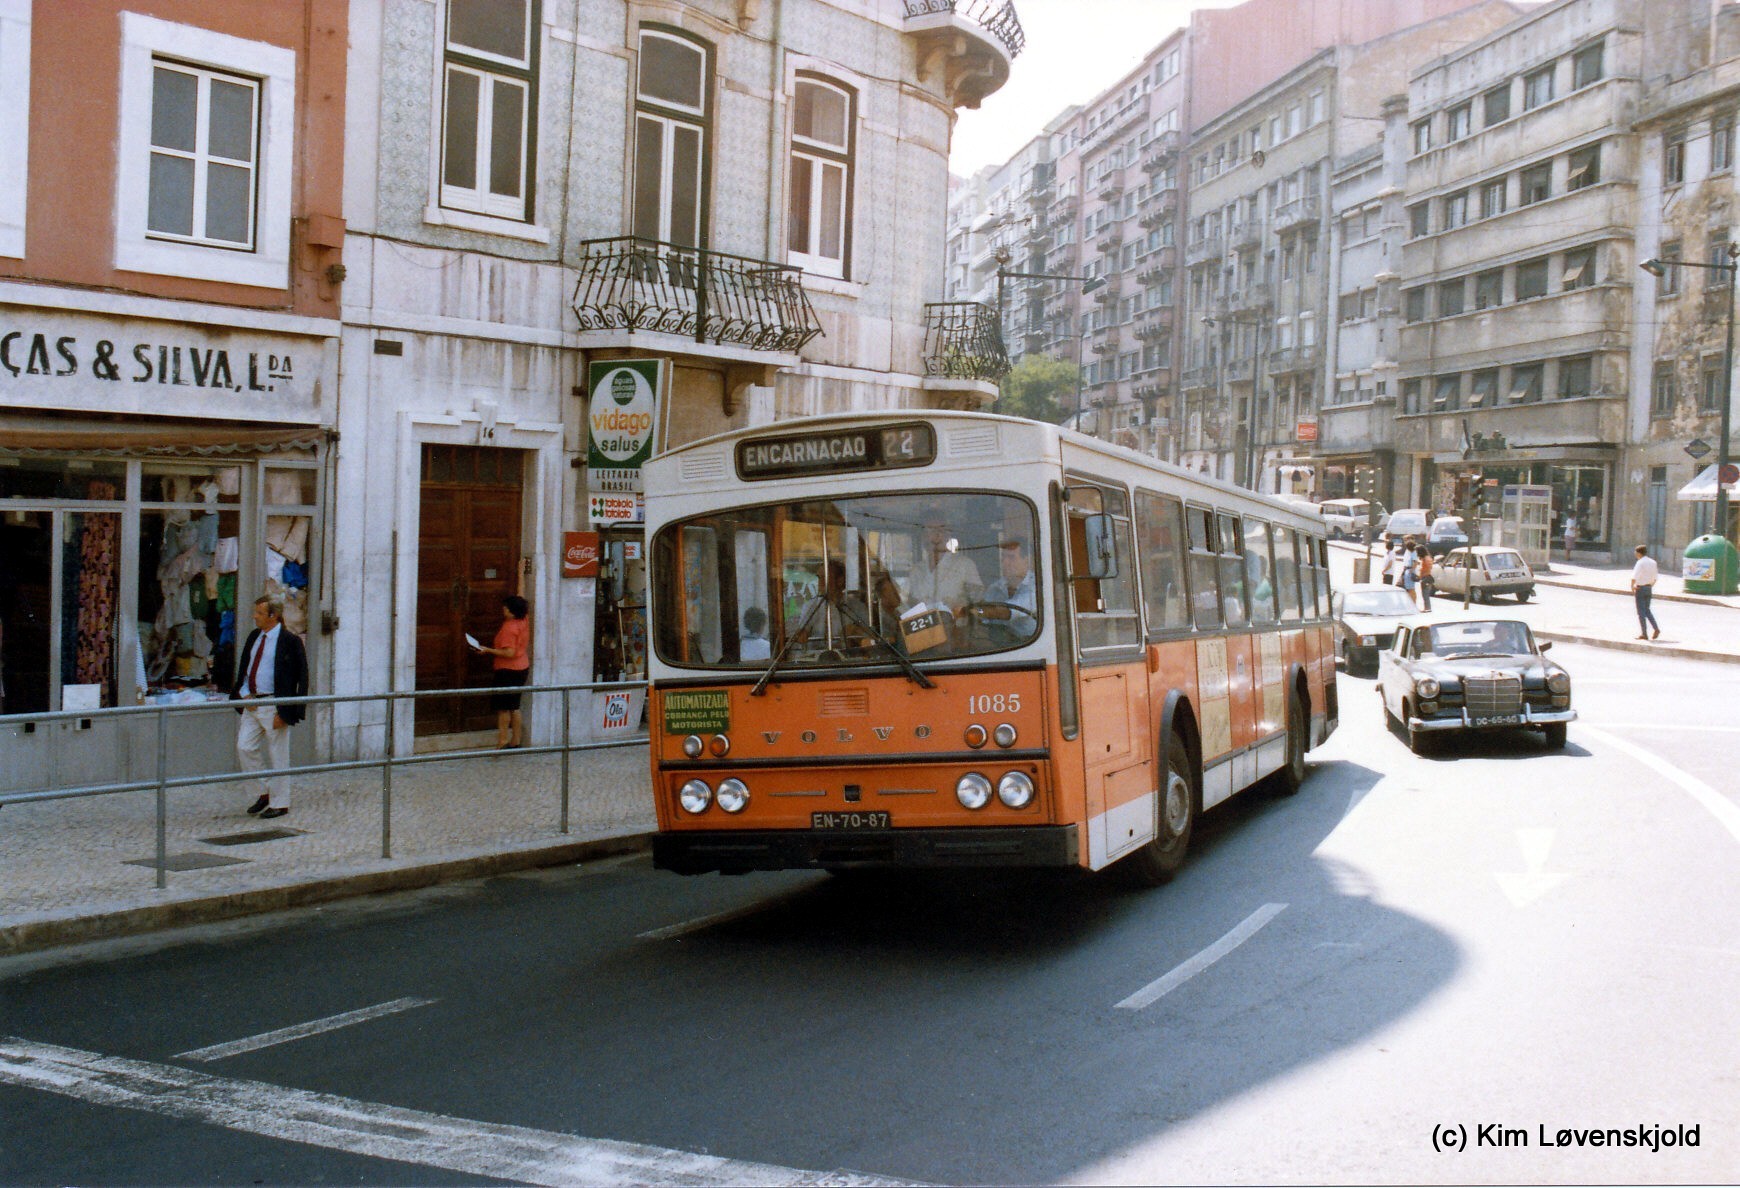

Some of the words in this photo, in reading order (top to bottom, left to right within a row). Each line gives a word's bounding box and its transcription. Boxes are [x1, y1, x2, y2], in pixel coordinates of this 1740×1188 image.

[92, 340, 121, 382] &
[592, 408, 650, 436] vidago
[483, 427, 494, 439] 16
[601, 436, 640, 452] salus
[596, 470, 640, 479] LEITARIA
[601, 481, 633, 491] BRASIL
[910, 614, 934, 632] 22-1
[969, 693, 1021, 715] 1085
[671, 720, 722, 729] MOTORISTA
[761, 724, 932, 745] VOLVO
[812, 813, 889, 829] EN-70-87
